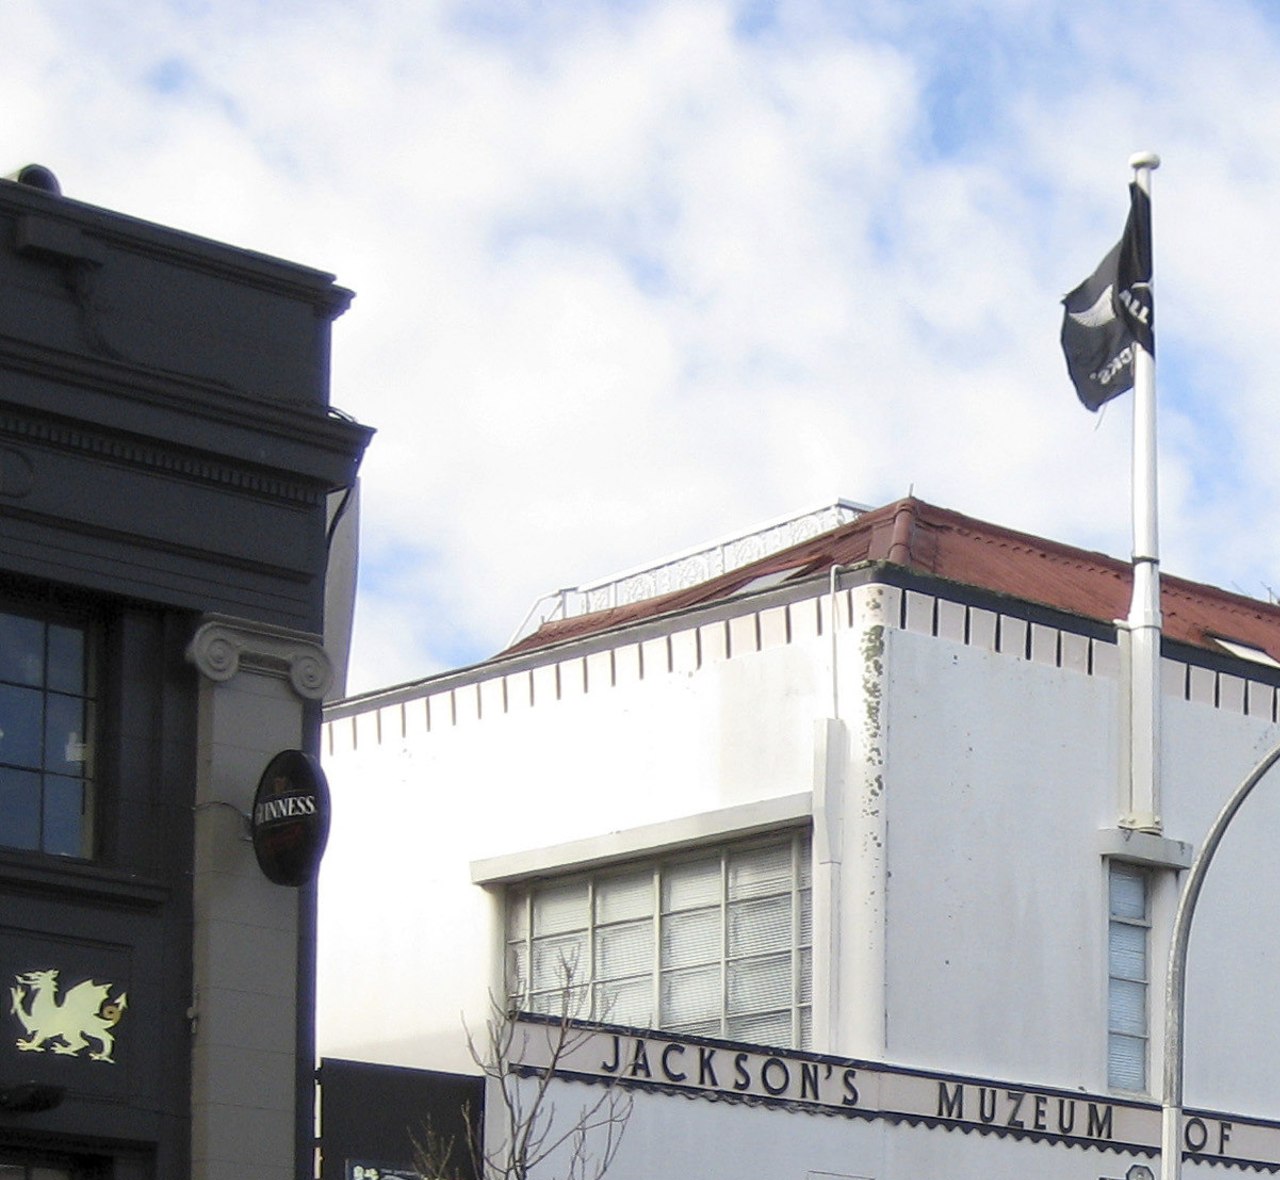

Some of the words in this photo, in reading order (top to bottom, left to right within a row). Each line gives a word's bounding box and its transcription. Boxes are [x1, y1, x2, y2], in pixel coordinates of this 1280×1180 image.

[602, 1033, 860, 1107] JACKSON'S
[938, 1080, 1115, 1141] MUZEUM
[1184, 1115, 1233, 1155] OF
